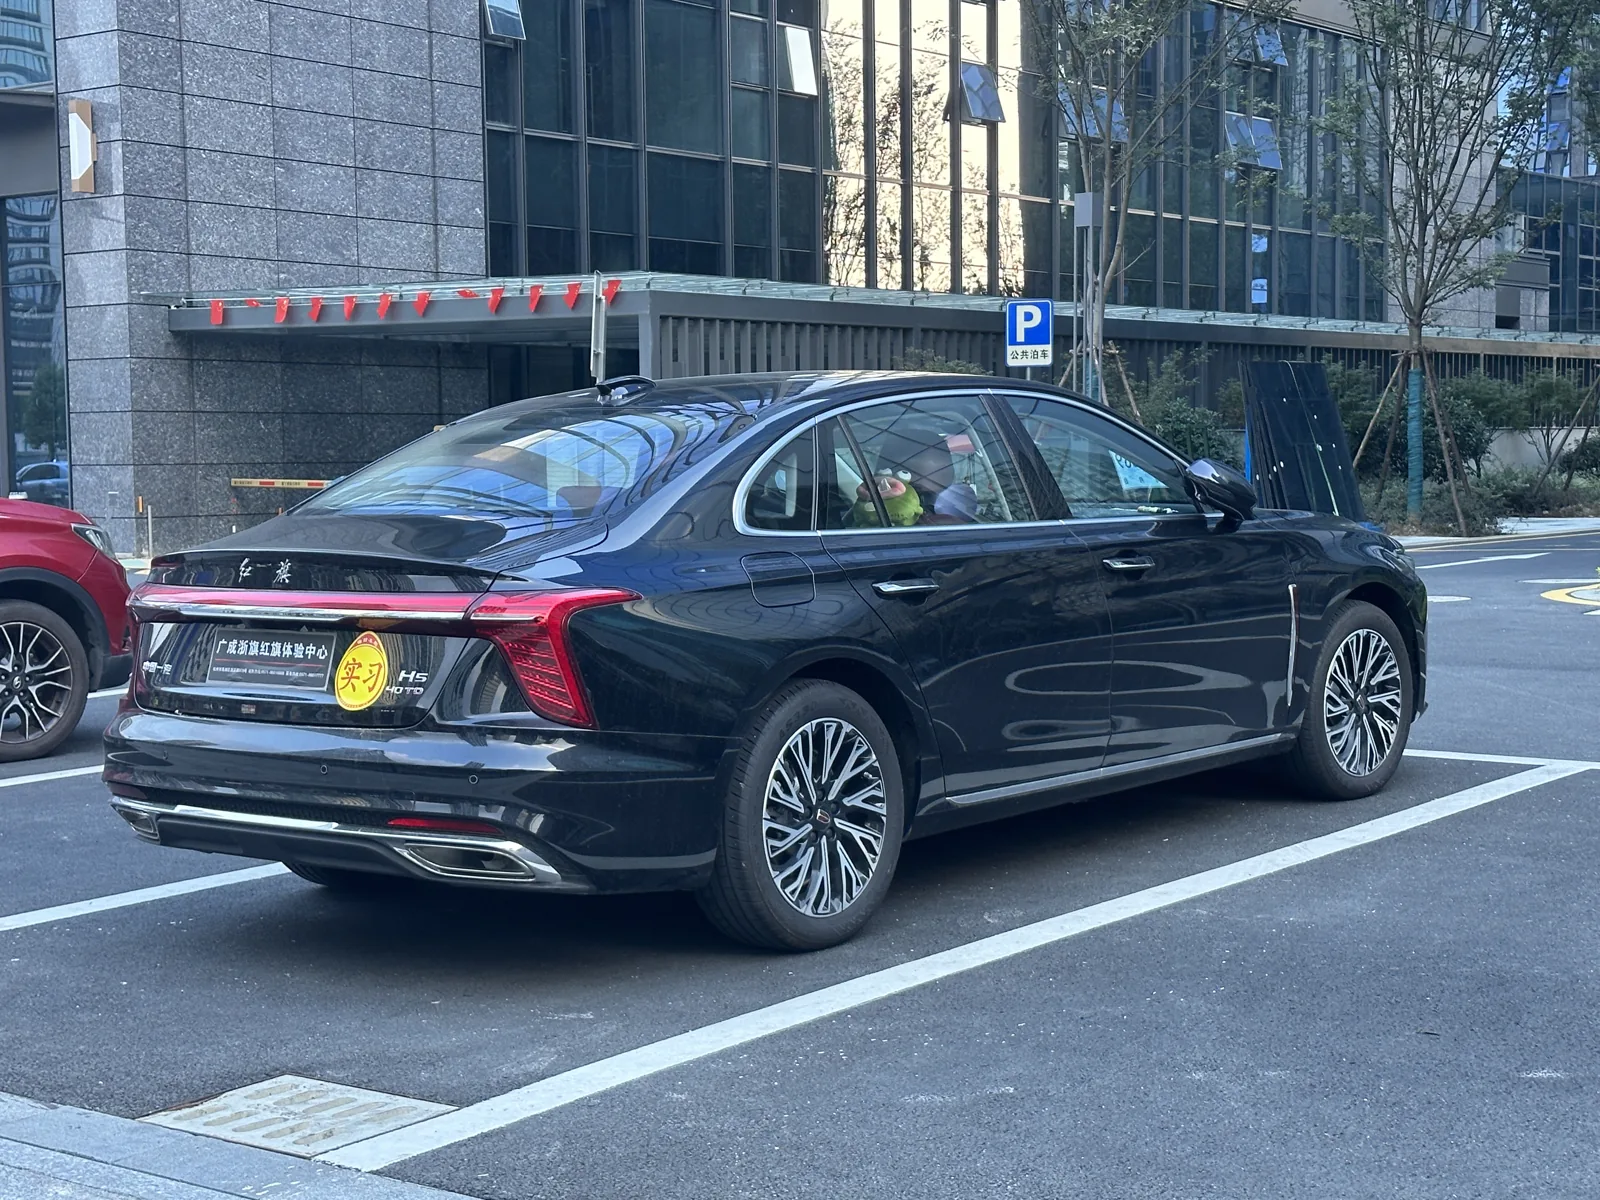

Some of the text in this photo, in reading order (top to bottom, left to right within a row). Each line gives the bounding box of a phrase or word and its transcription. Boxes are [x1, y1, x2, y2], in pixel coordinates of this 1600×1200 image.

[1016, 304, 1042, 342] P
[1010, 349, 1049, 360] 公共泊车
[216, 639, 328, 660] 广成浙旗红旗体验中心
[339, 657, 383, 693] 实习
[398, 670, 429, 683] H5
[385, 685, 424, 695] 40TD
